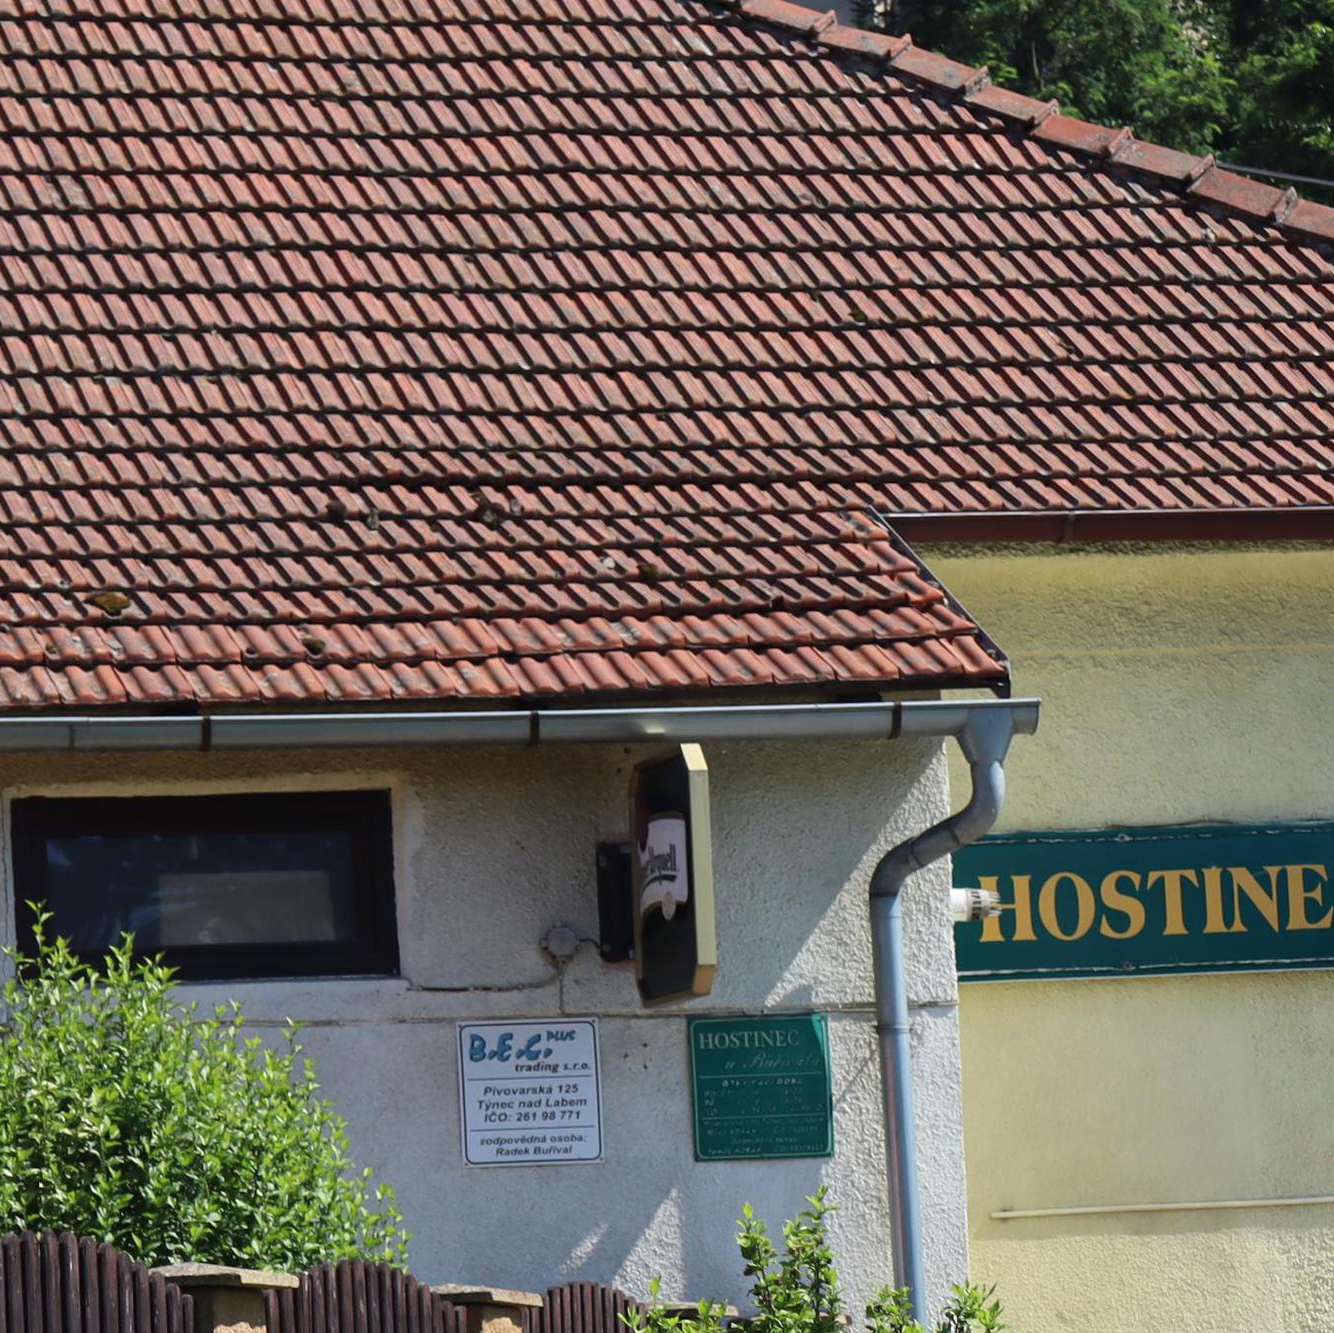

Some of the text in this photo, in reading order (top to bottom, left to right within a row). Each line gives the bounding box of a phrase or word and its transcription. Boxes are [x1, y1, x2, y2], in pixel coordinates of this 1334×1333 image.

[698, 1029, 800, 1049] HOSTINEC
[514, 1061, 591, 1073] trading s.r.o.
[483, 1083, 579, 1097] Pivovarská 125
[477, 1097, 588, 1112] Týnec nad Labem
[484, 1110, 581, 1123] IČO: 261 98 771
[479, 1132, 587, 1147] zodpovědná osoba:
[495, 1144, 573, 1157] Radek Buřival
